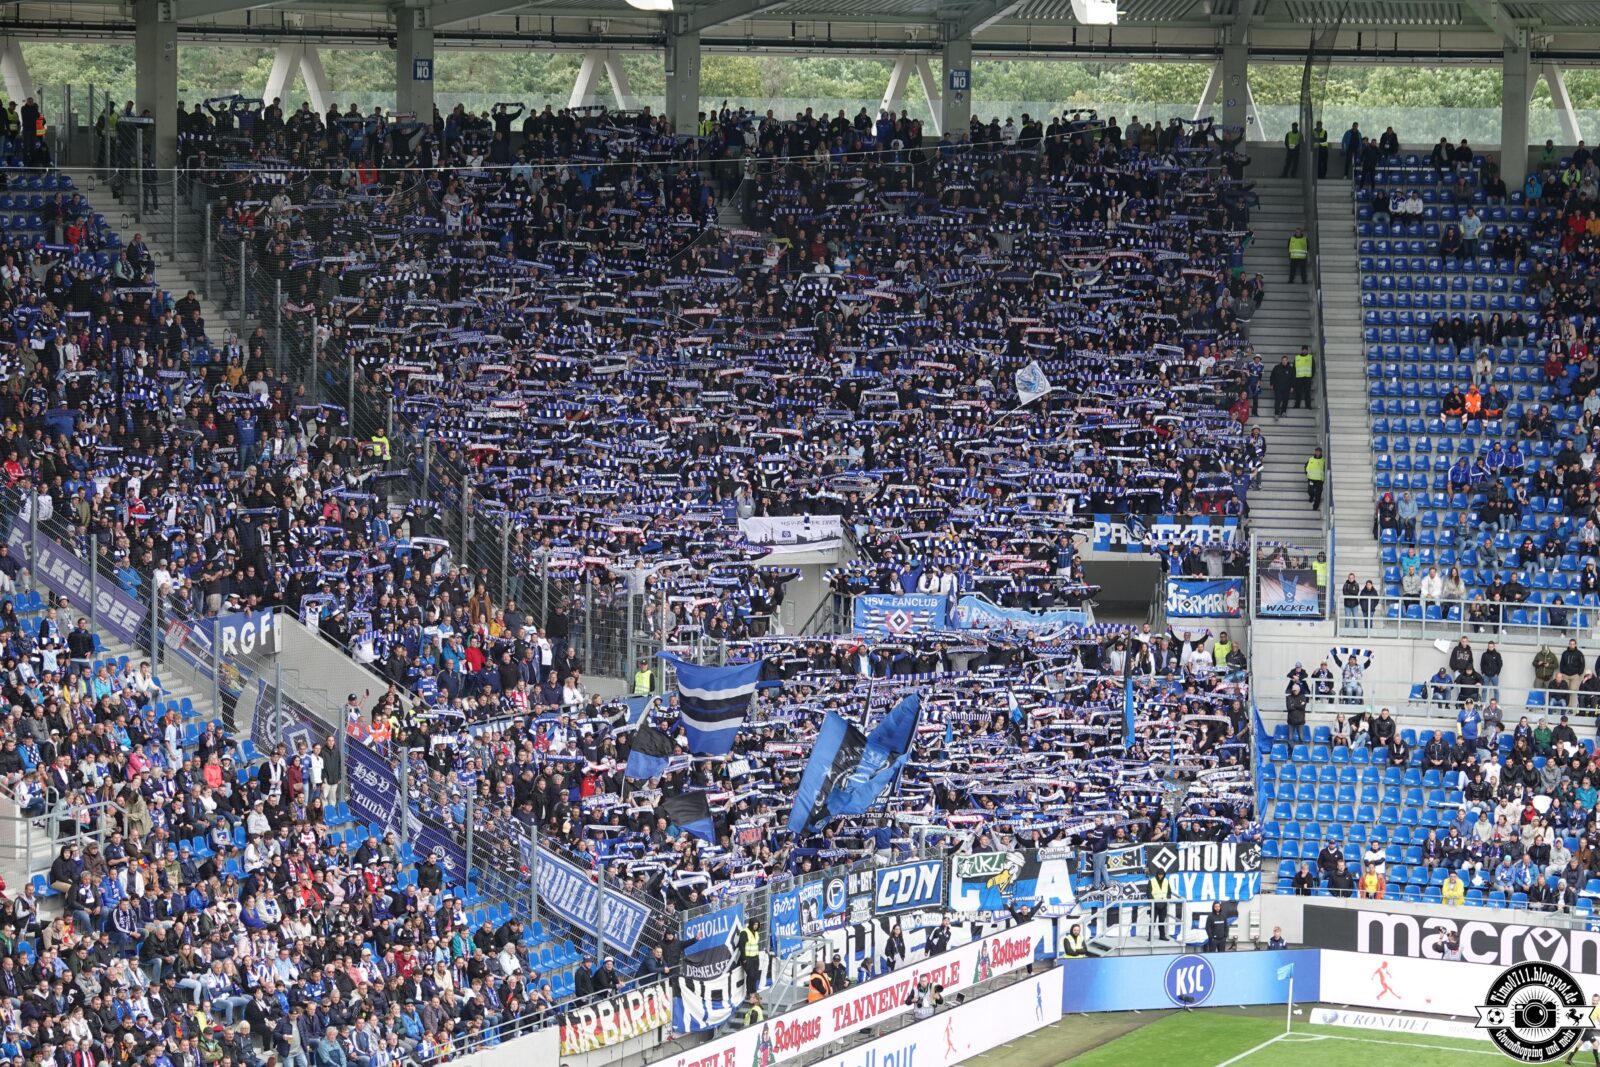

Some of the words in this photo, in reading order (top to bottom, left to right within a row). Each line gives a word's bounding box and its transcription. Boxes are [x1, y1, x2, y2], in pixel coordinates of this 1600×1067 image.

[864, 596, 884, 606] HSV
[891, 597, 938, 607] FANCLUB
[1266, 604, 1315, 612] WACKEN
[1178, 842, 1237, 872] IRON
[877, 863, 941, 908] CDN
[1168, 872, 1260, 901] OYALTY
[686, 914, 729, 940] SCHOLLI
[1357, 910, 1600, 976] macron
[774, 1015, 822, 1053] Rothaus
[990, 936, 1032, 969] Rothaus
[1175, 964, 1205, 996] KSC
